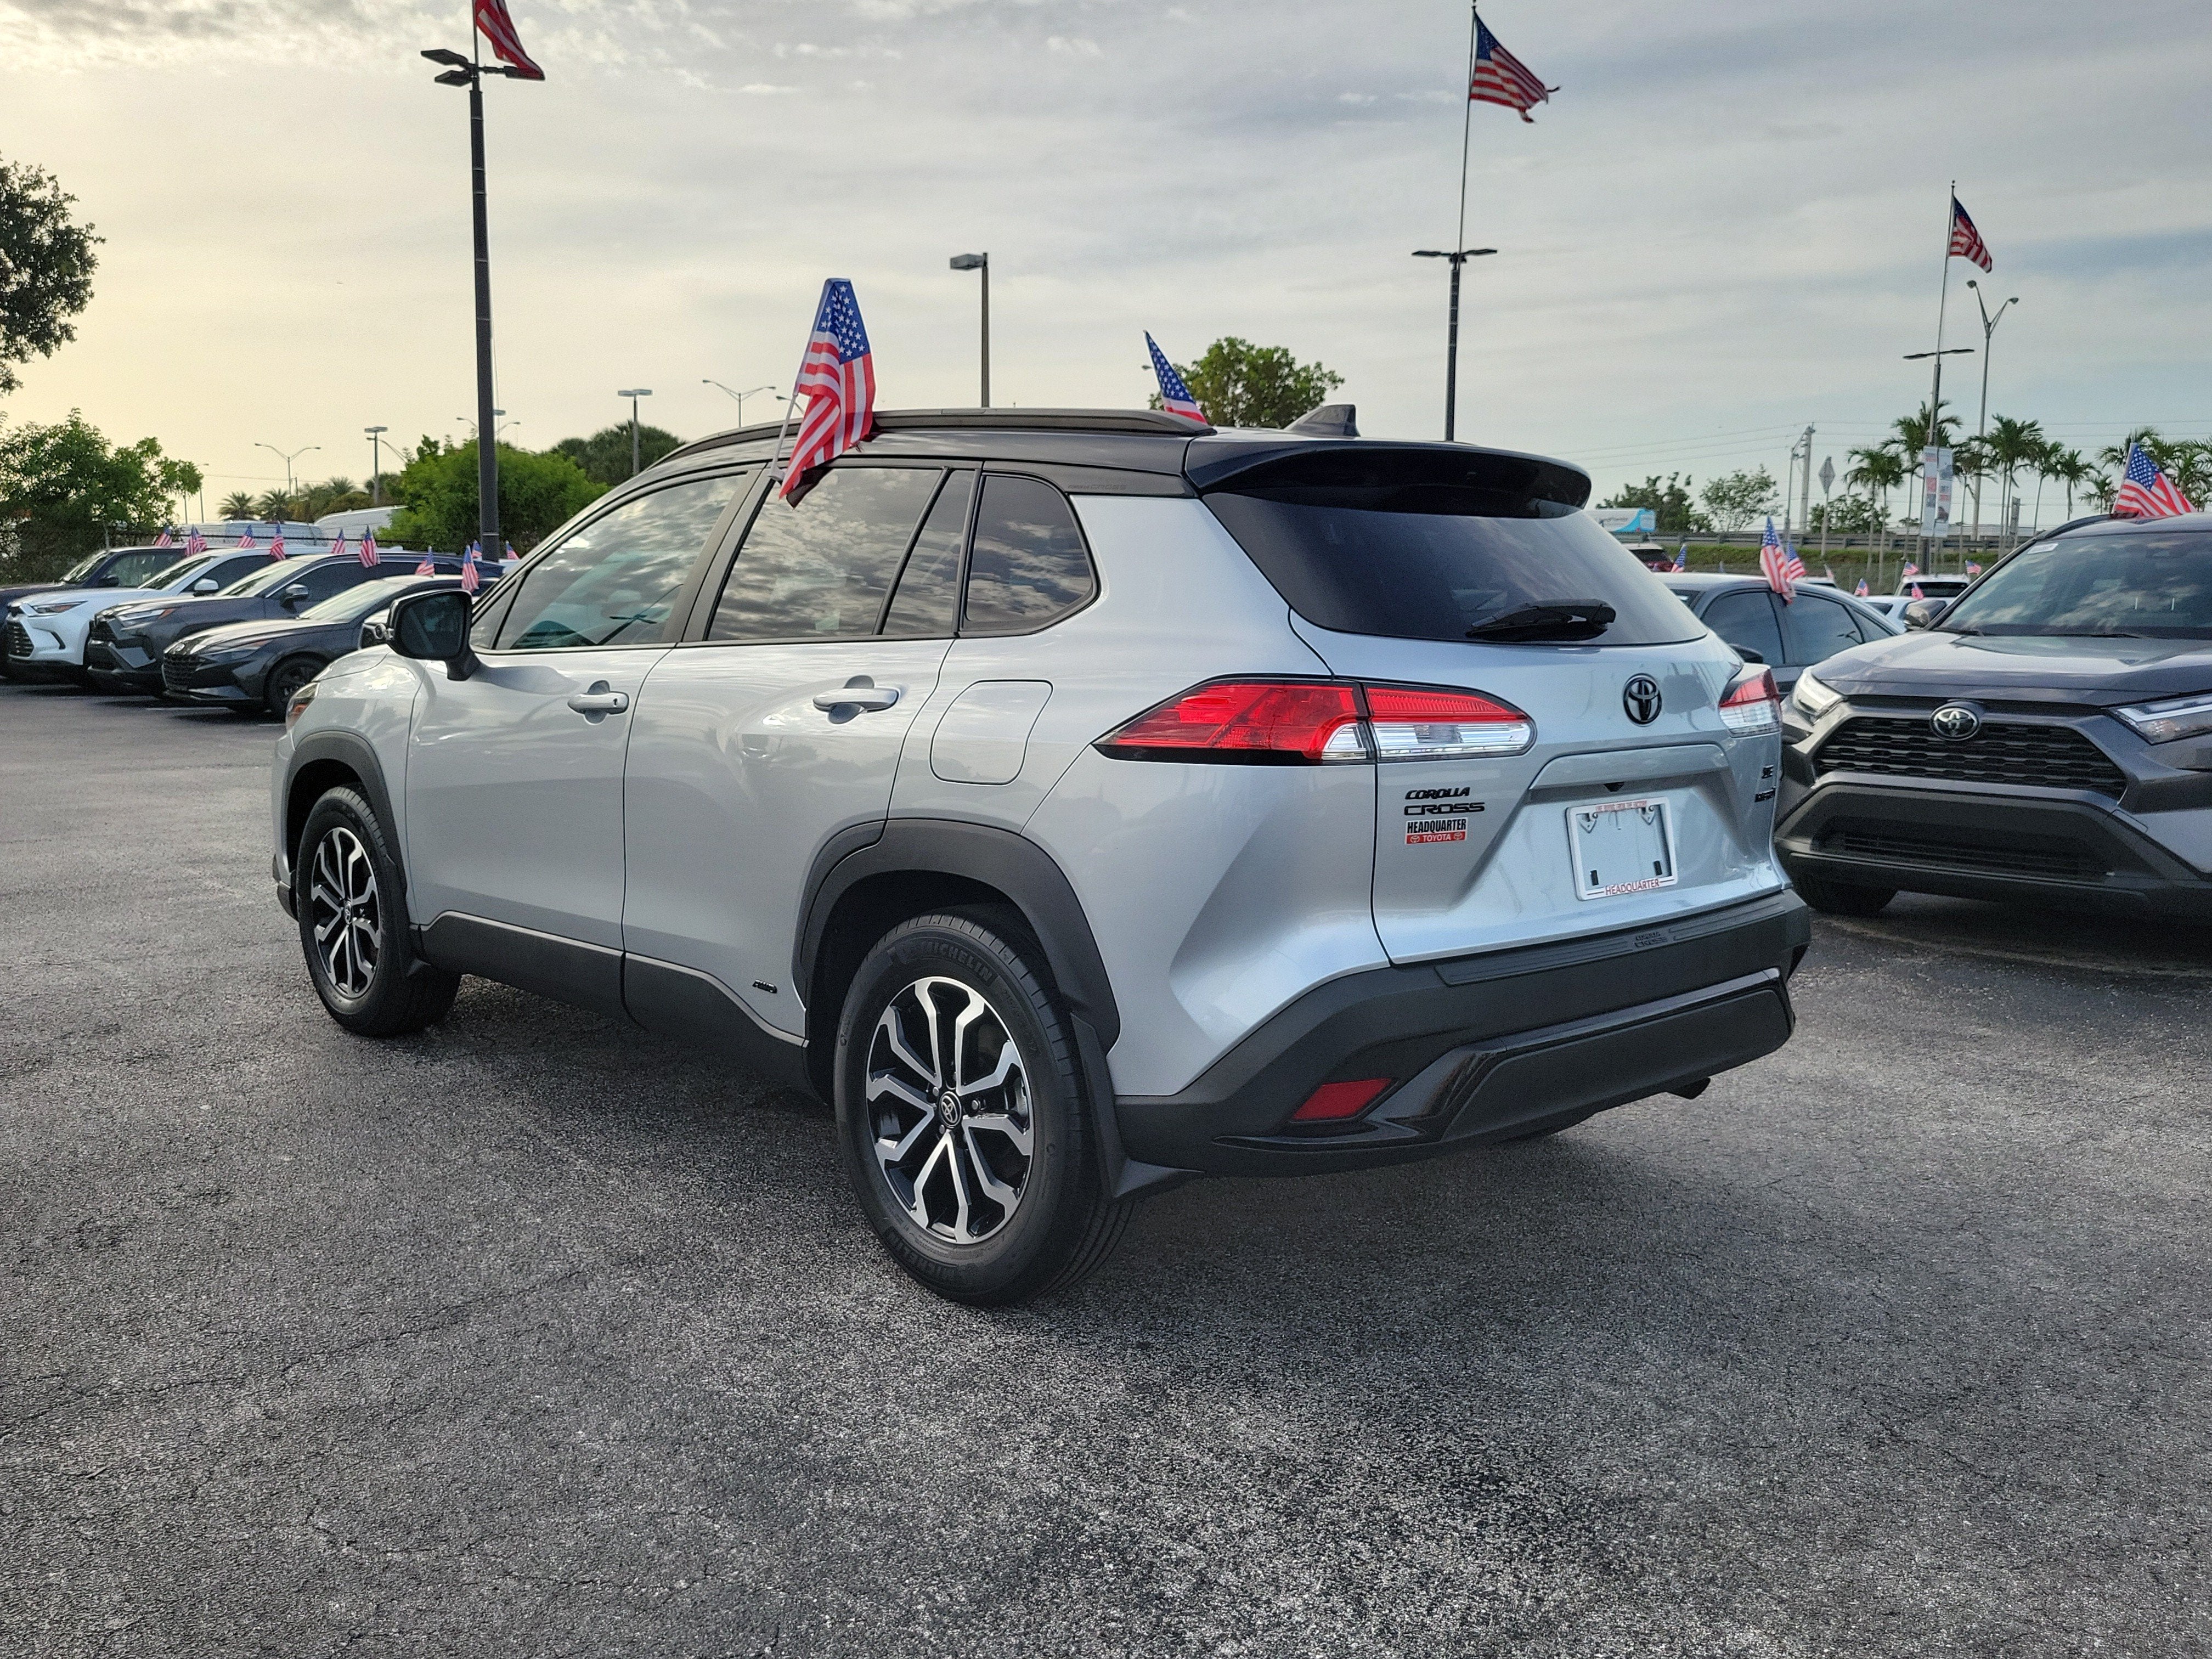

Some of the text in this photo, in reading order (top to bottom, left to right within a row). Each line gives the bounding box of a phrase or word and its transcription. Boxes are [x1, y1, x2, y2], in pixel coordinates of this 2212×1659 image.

[1405, 787, 1471, 800] COROLLA
[1404, 802, 1485, 816] CROSS
[1407, 819, 1466, 834] HEADQUARTER
[1422, 833, 1451, 842] TOYOTA
[1605, 878, 1660, 895] HEADQUARTER
[921, 941, 993, 982] MICHELIN
